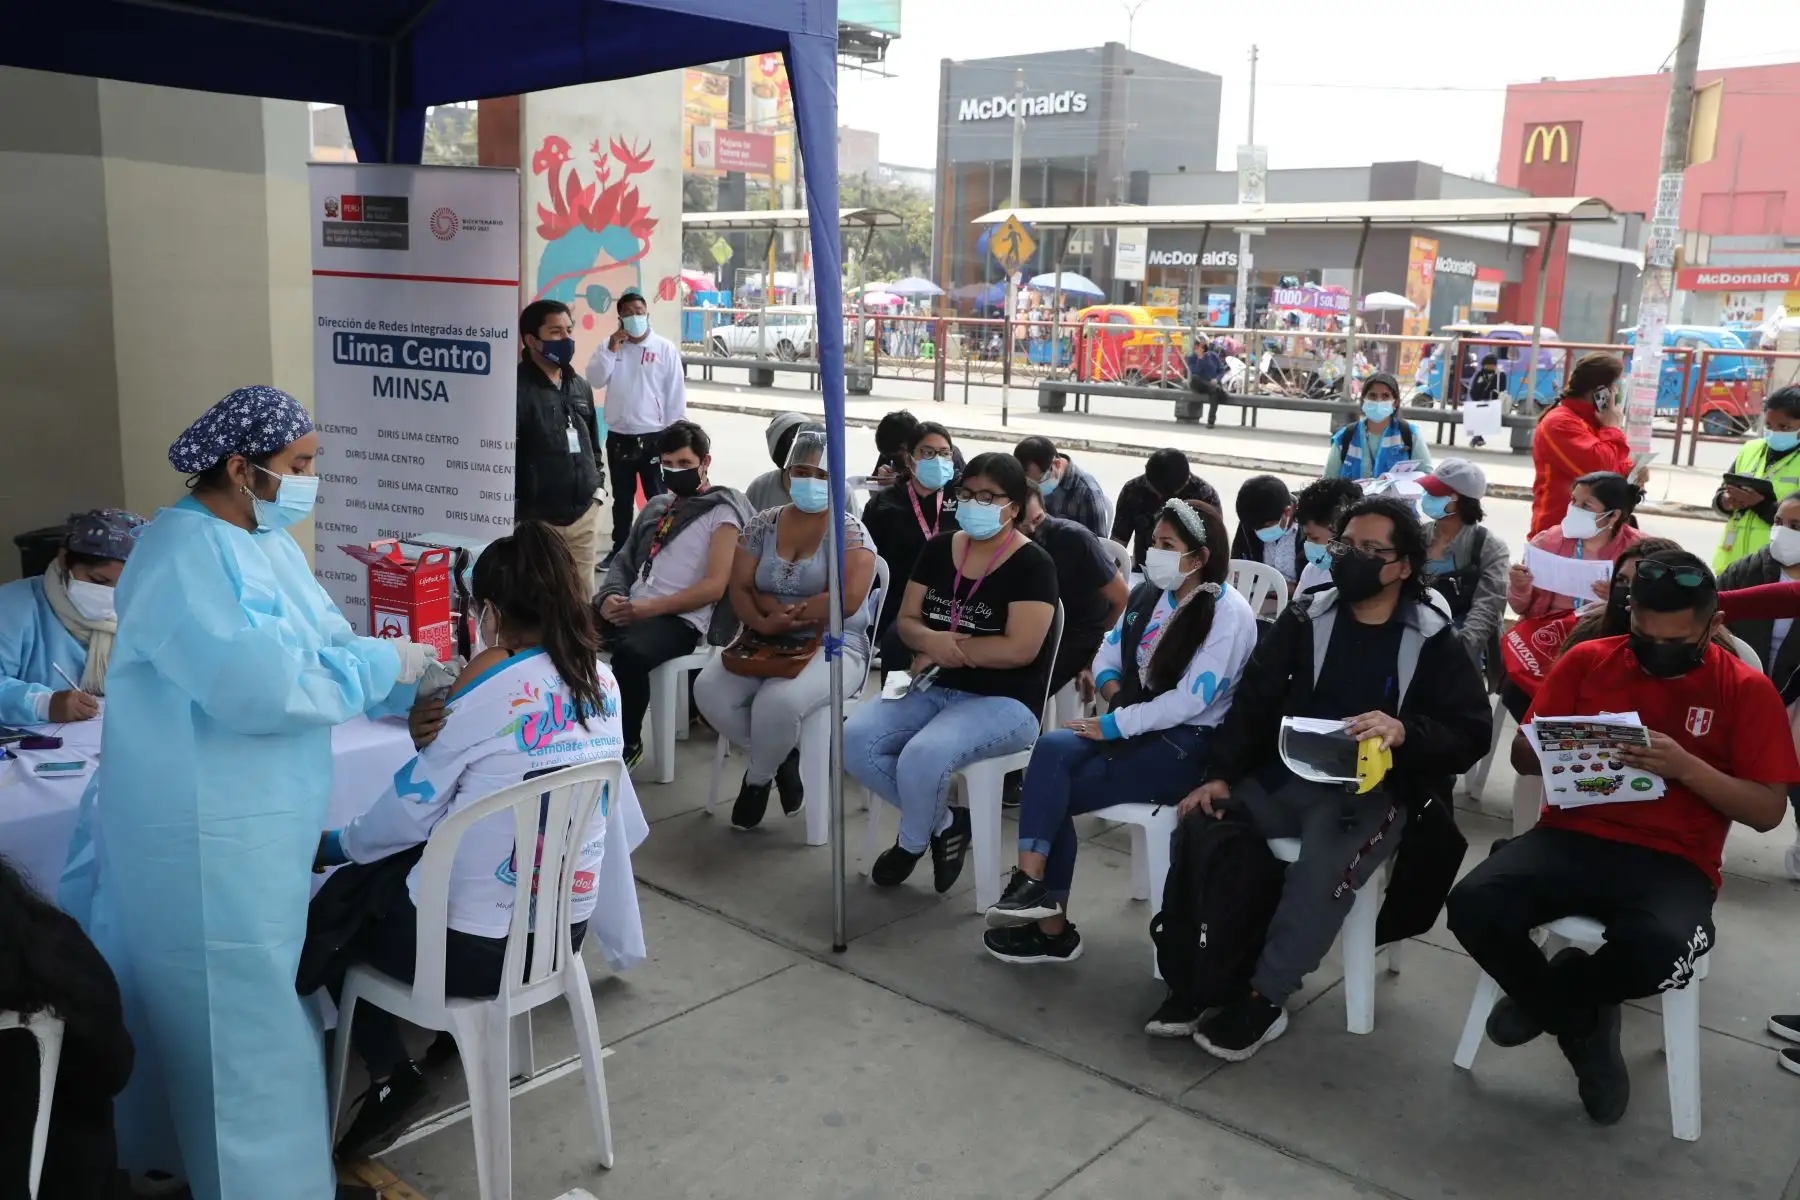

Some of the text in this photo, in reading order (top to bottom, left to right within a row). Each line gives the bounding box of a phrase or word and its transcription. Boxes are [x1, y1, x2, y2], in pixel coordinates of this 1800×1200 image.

[959, 91, 1087, 120] McDonald's
[1435, 256, 1477, 277] McDonald's
[1697, 272, 1790, 285] McDonald's
[1273, 289, 1301, 305] TODO
[318, 316, 509, 339] Dirección de Redes Integradas de Salud
[336, 335, 488, 371] Lima Centro
[373, 375, 449, 403] MINSA
[325, 424, 358, 436] CENTRO
[378, 429, 460, 445] DIRIS LIMA CENTRO
[480, 439, 516, 450] DIRIS LI
[345, 449, 425, 466] DIRIS LIMA CENTRO
[446, 459, 515, 474] DIRIS LIMA CEN
[325, 473, 358, 485] CENTRO
[378, 479, 459, 496] DIRIS LIMA CENTRO
[480, 490, 515, 502] DIRIS LI
[345, 499, 425, 516] DIRIS LIMA CENTRO
[446, 510, 514, 526] DIRIS LIMA CEN
[325, 522, 358, 534] CENTRO
[378, 528, 400, 539] DIRIS
[325, 570, 358, 582] CENTRO
[345, 595, 366, 607] DIRIS
[975, 602, 993, 619] Big
[1507, 631, 1545, 677] HIKVISION
